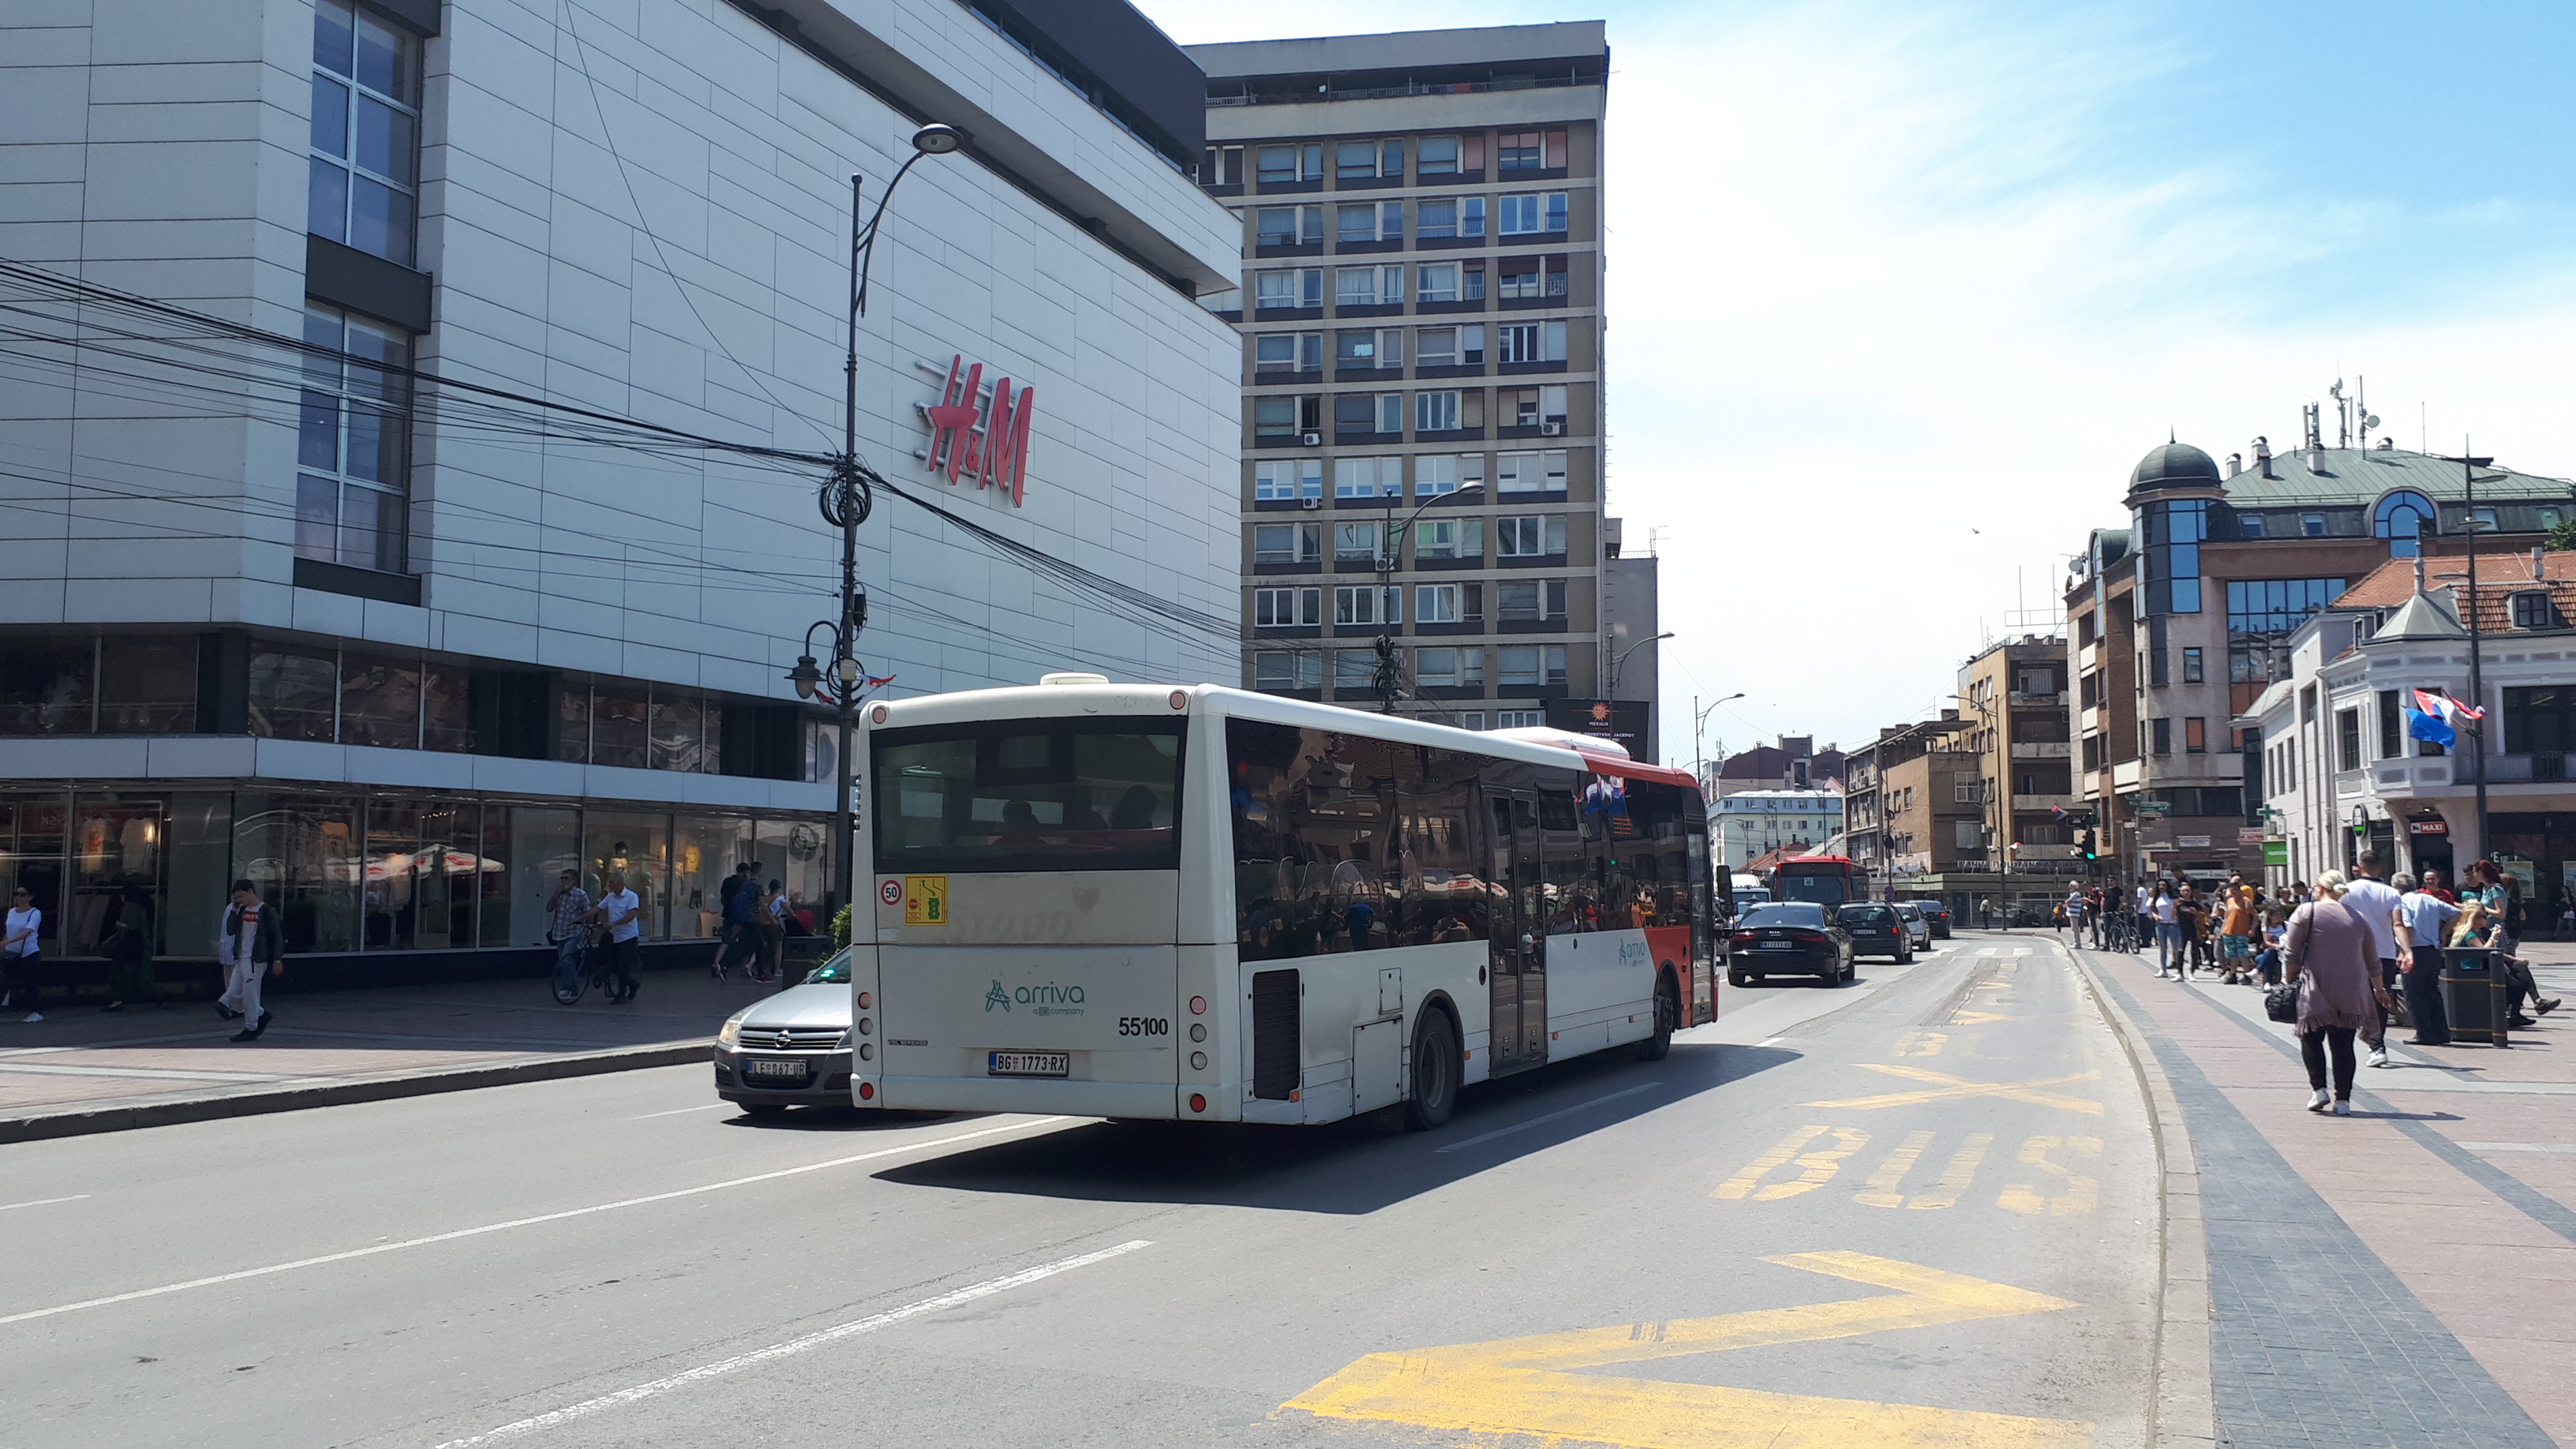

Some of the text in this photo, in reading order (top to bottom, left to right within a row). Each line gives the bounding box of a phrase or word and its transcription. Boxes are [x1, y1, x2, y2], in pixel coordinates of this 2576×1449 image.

[928, 354, 1034, 507] H&M
[886, 887, 897, 898] 50
[1015, 981, 1084, 1004] arriva
[1118, 1017, 1168, 1036] 55100
[998, 1056, 1012, 1069] BG
[1707, 1125, 2106, 1216] BUS
